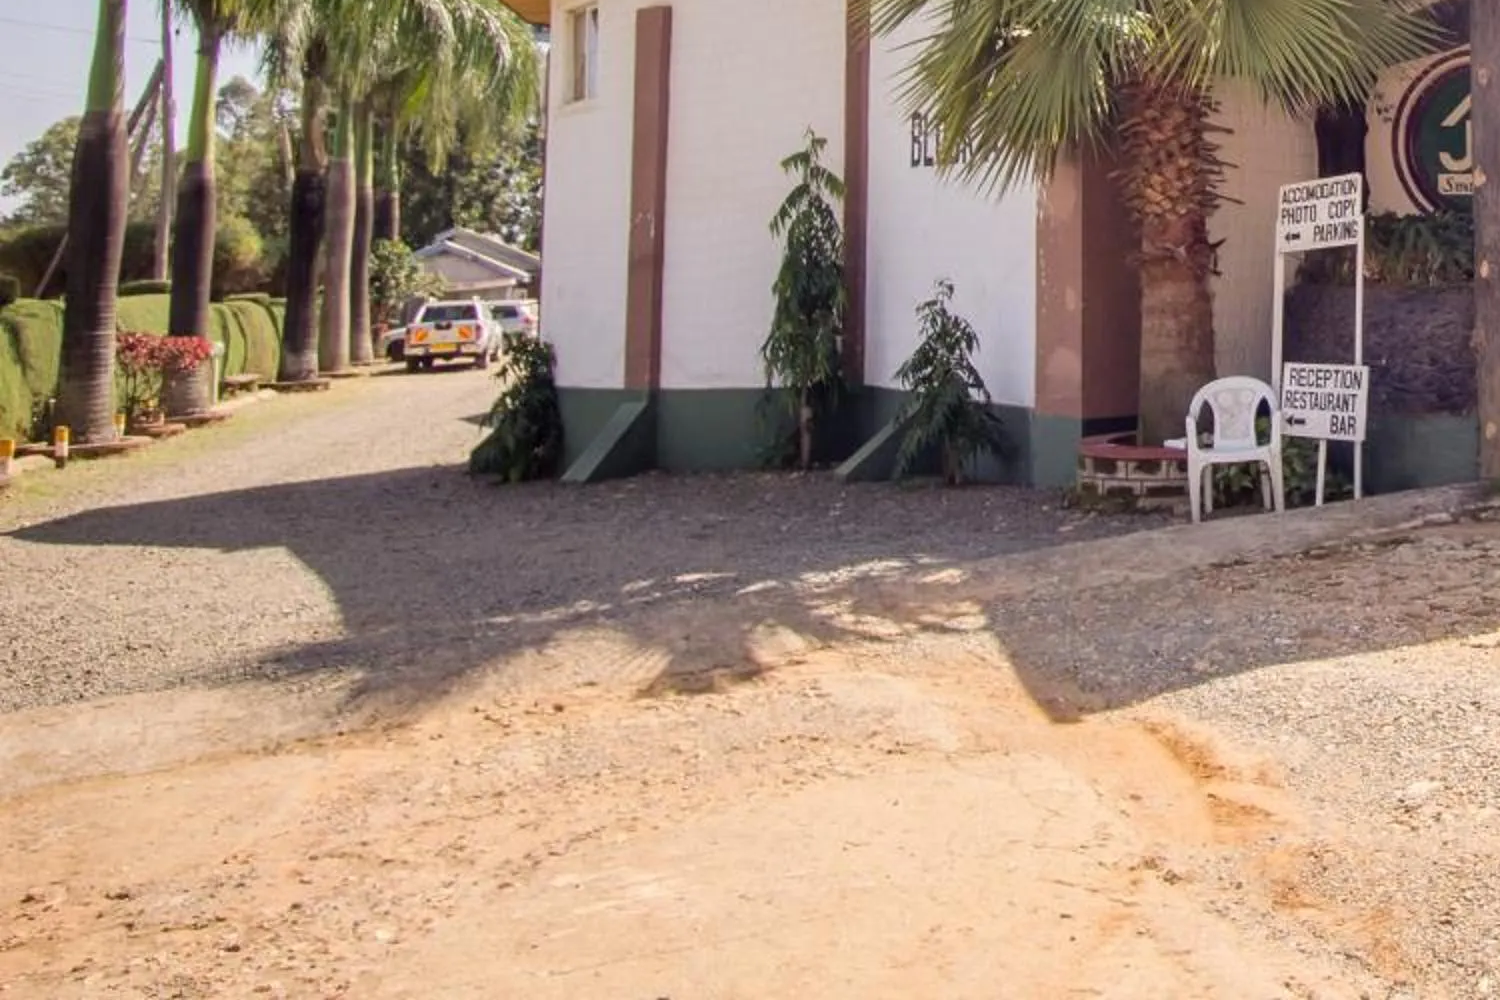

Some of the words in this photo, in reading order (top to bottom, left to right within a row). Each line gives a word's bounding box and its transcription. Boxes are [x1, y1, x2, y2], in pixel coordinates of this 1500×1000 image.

[1281, 204, 1317, 225] PHOTO
[1327, 198, 1357, 220] COPY
[1313, 220, 1359, 242] PARKING
[1289, 367, 1363, 390] RECEPTION
[1283, 389, 1358, 412] RESTAURANT
[1329, 414, 1357, 435] BAR
